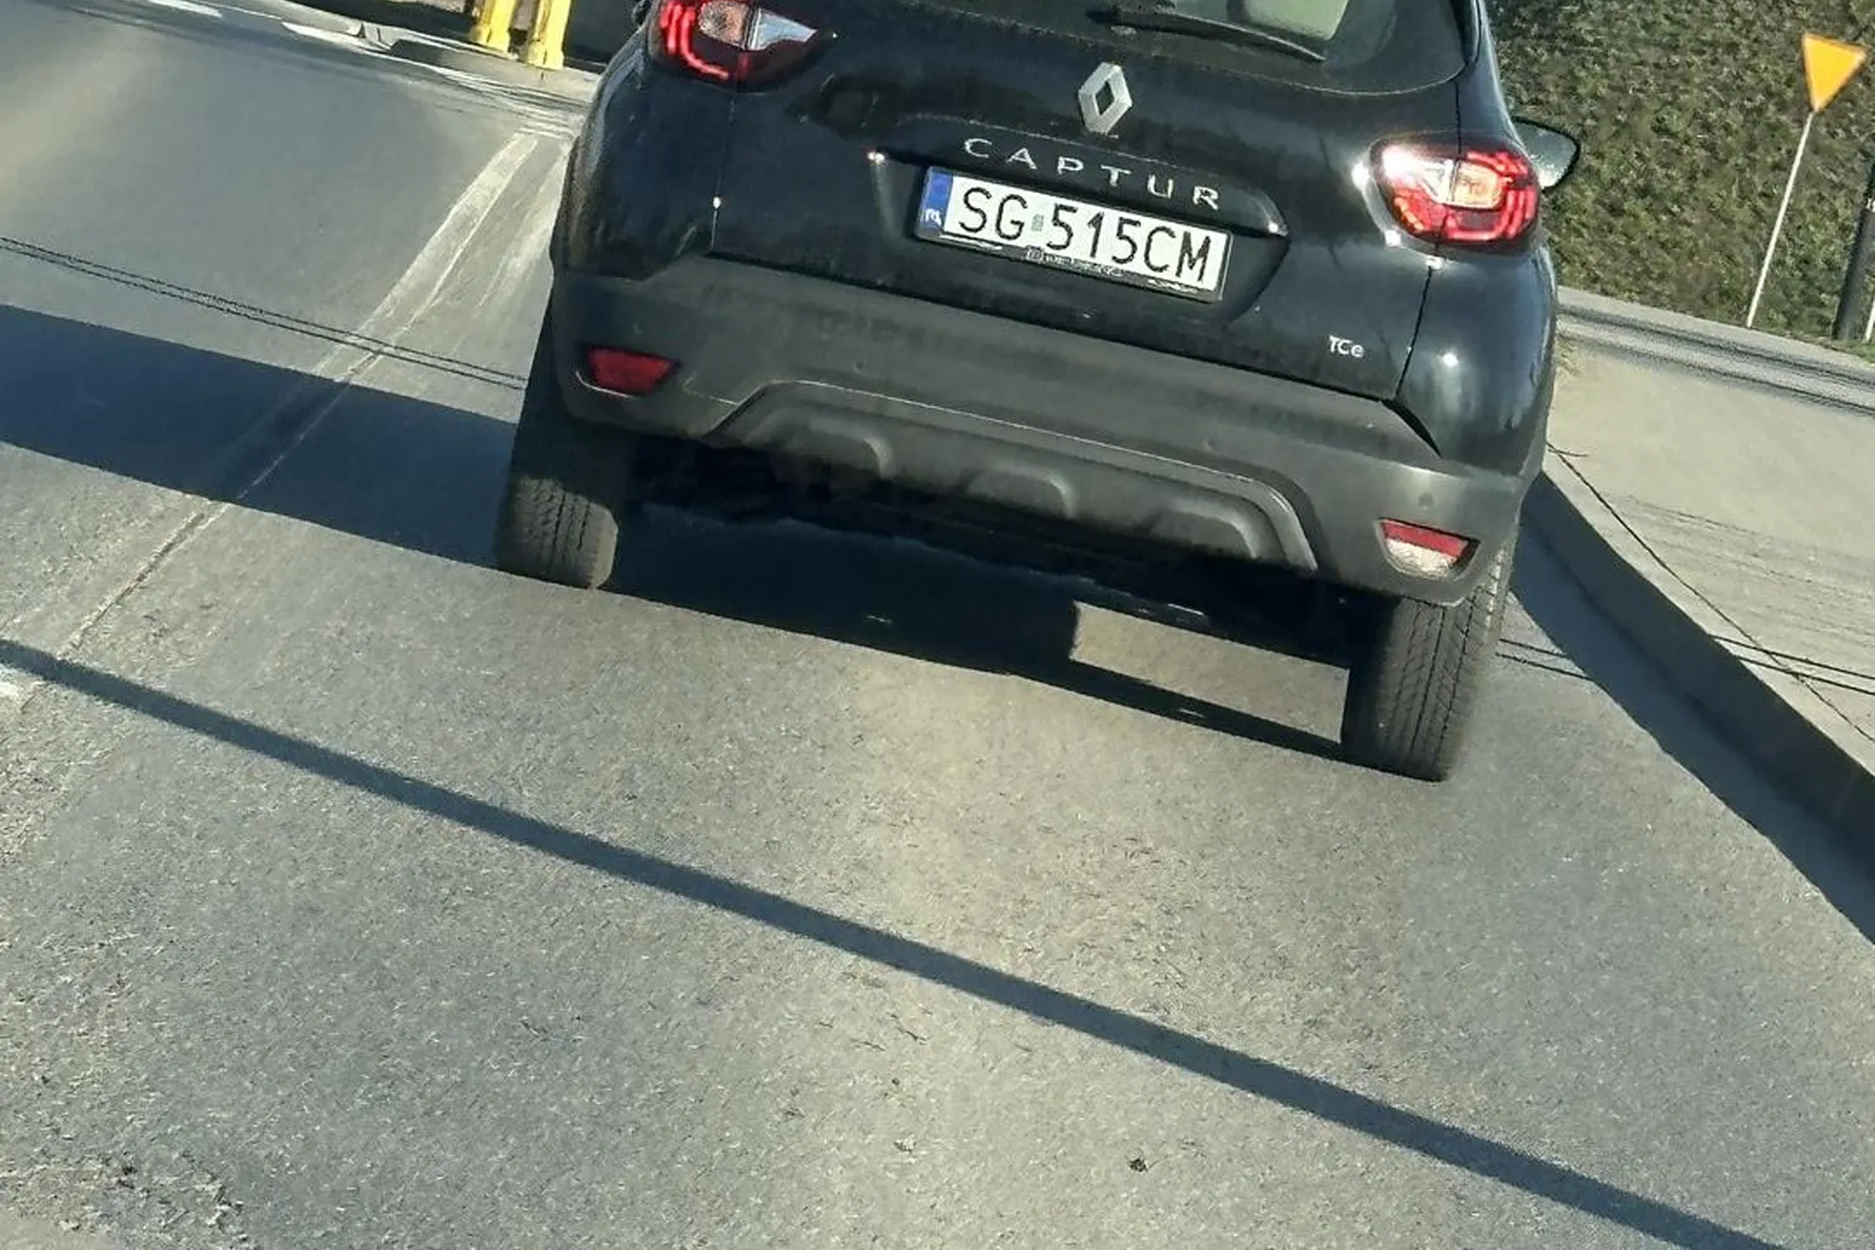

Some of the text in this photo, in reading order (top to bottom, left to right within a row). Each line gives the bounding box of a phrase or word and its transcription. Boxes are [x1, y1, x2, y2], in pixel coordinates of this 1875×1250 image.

[963, 138, 1219, 210] CAPTUR
[958, 187, 1028, 240] SG
[1046, 203, 1211, 282] 515CM
[1329, 335, 1364, 358] TCe
